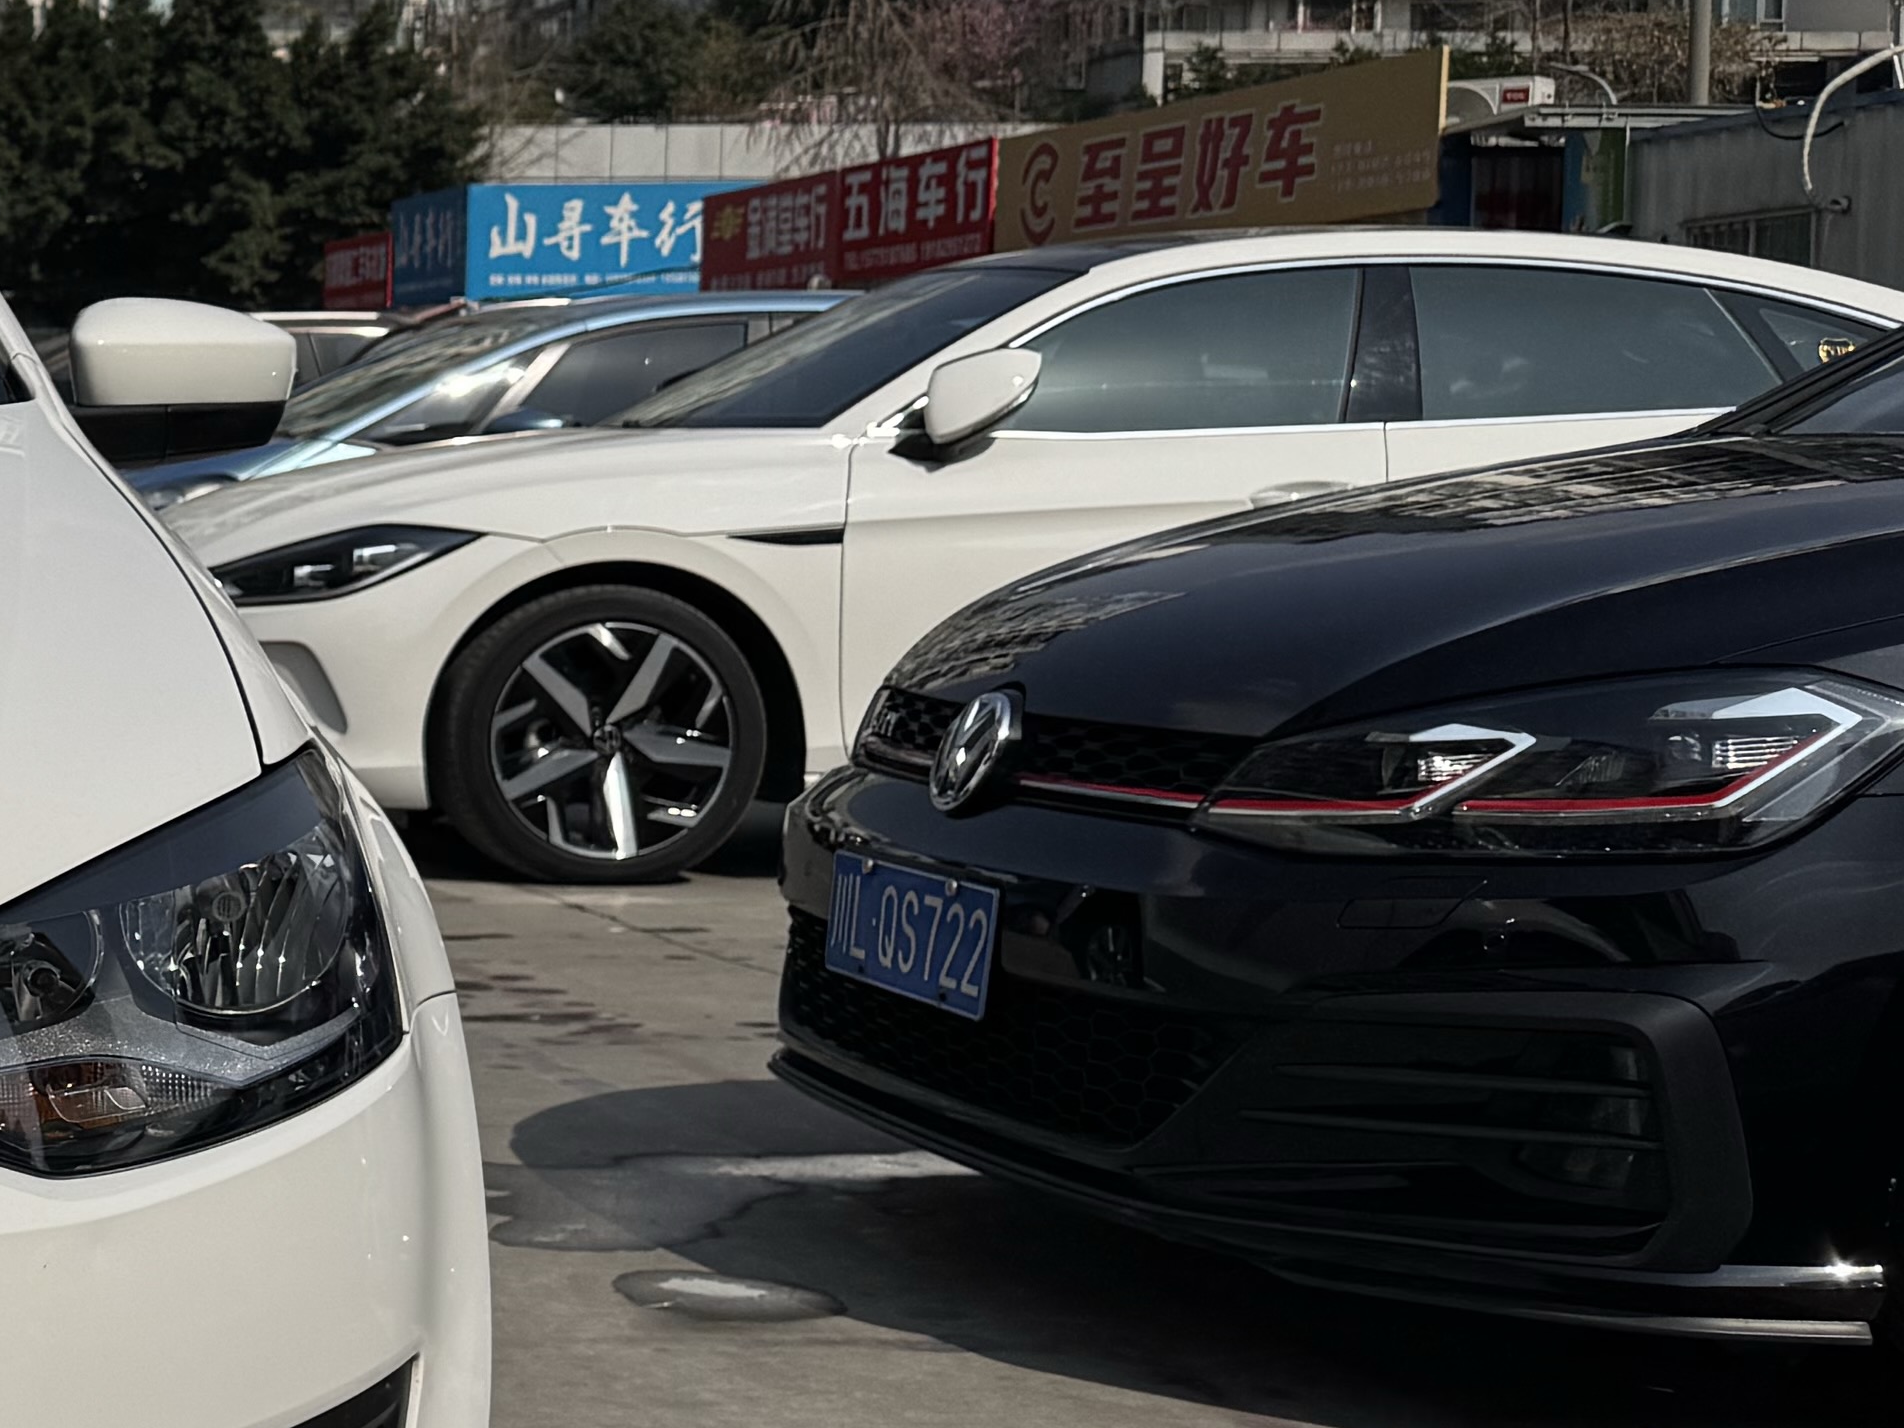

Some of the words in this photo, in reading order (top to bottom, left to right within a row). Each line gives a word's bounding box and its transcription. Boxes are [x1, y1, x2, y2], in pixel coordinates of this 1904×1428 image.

[1073, 102, 1322, 228] 至呈好车
[489, 192, 703, 267] 山寻车行
